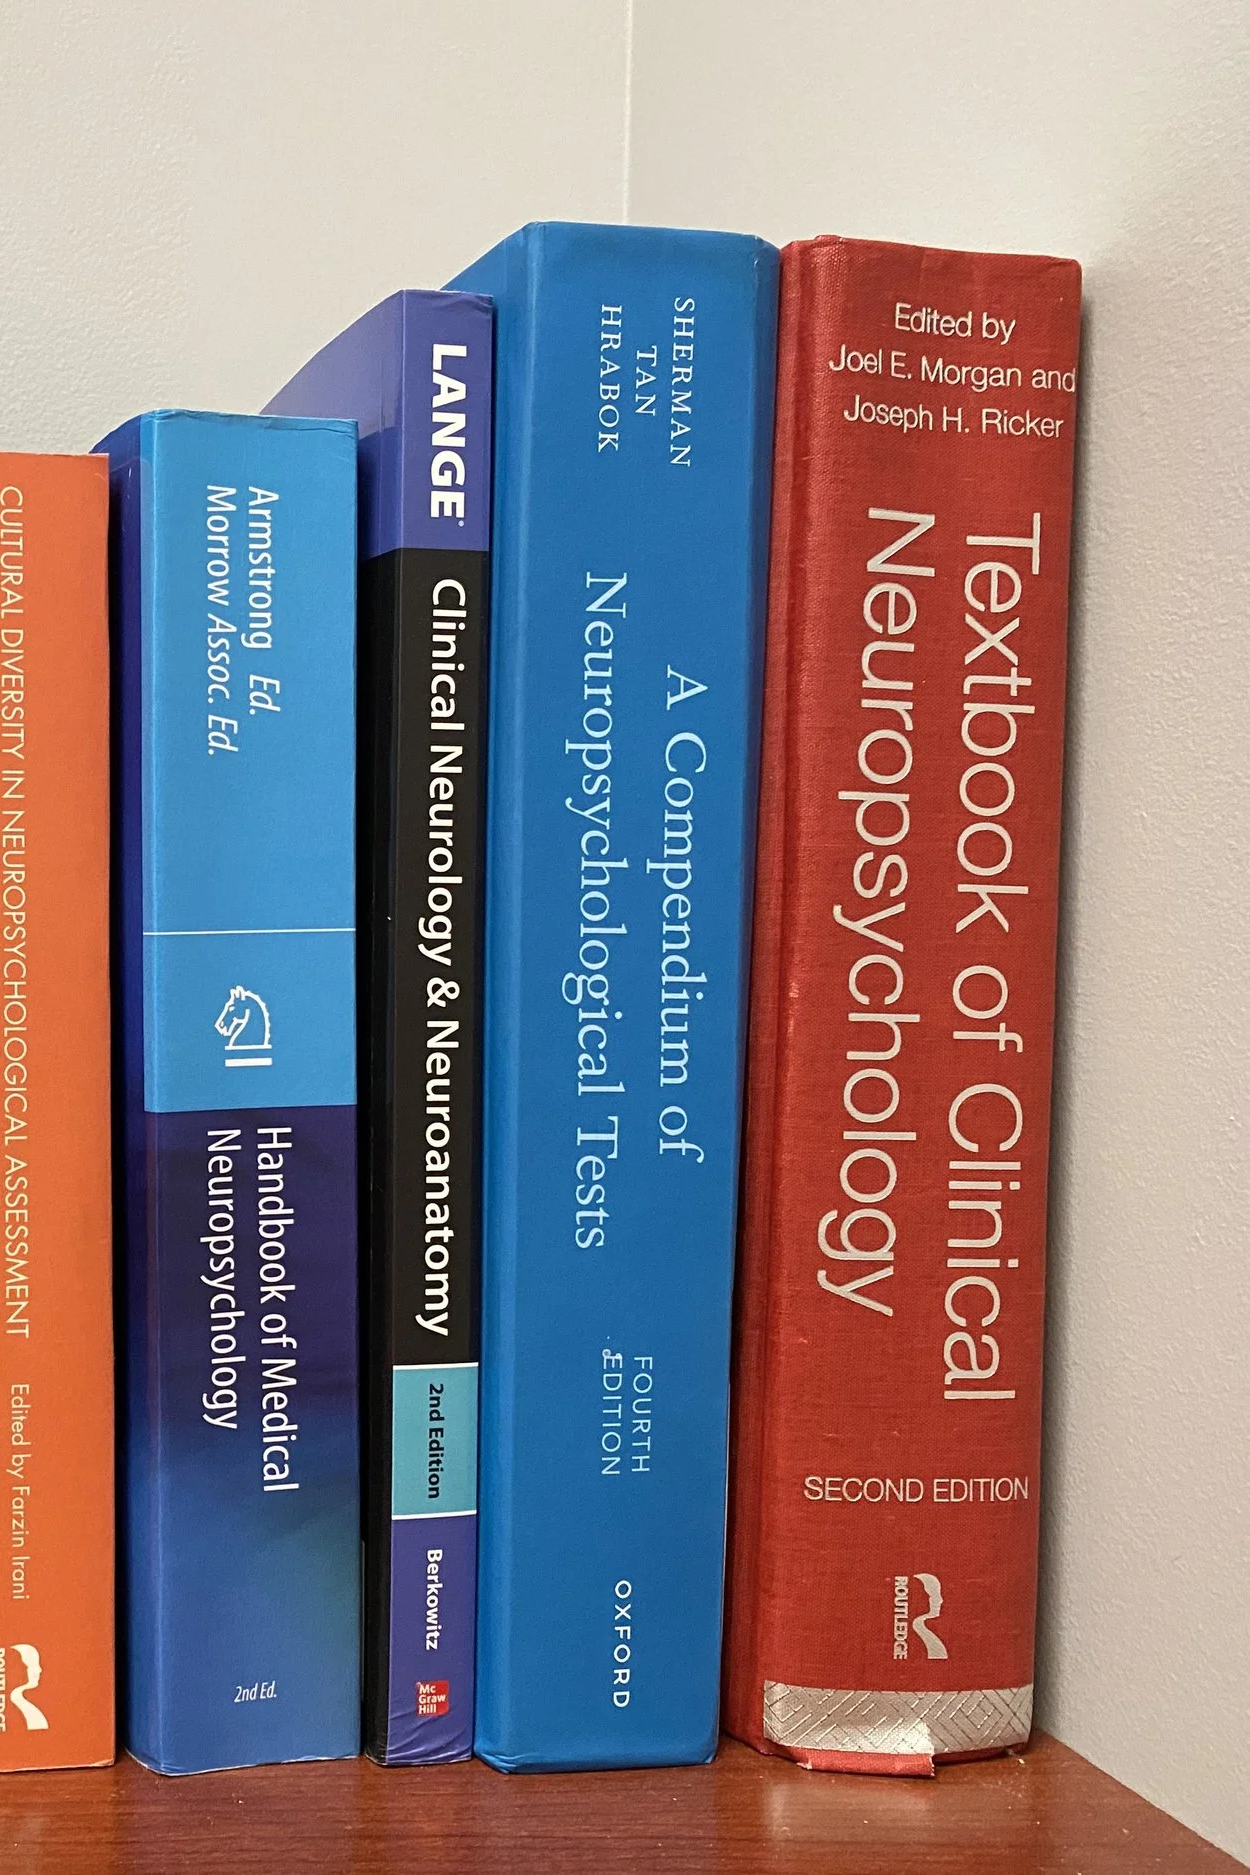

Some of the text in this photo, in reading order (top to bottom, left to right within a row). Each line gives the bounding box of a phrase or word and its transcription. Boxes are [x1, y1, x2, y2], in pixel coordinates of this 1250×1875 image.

[598, 304, 623, 453] HRABOK
[635, 345, 658, 417] TAN
[669, 297, 696, 467] SHERMAN
[828, 343, 1076, 393] Joel E. Morgan and
[894, 302, 1016, 346] Edited by
[843, 394, 1064, 438] Joseph H. Ricker
[206, 485, 239, 756] Morrow Assoc. Ed.
[240, 486, 281, 715] Armstrong Ed.
[0, 485, 30, 1339] CULTURAL DIVERSITY IN NEUROPSYCHOLOGICAL ASSESSMENT
[415, 578, 467, 1337] Clinical Neurology & Neuroanatomy
[561, 571, 629, 1249] Neuropsychological Tests
[646, 664, 709, 1164] A Compendium of
[816, 507, 936, 1317] Neuropsychology
[943, 512, 1041, 1400] Textbook of Clinical
[199, 1129, 247, 1430] Neuropsychology
[256, 1127, 300, 1492] Handbook of Medical
[427, 1383, 445, 1499] 2nd Edition
[601, 1350, 623, 1475] EDITION
[631, 1356, 653, 1472] FOURTH
[5, 1383, 32, 1600] Edited by Farzin Irani
[803, 1475, 1029, 1503] SECOND EDITION
[425, 1549, 443, 1651] Berkowitz
[613, 1579, 632, 1708] OXFORD
[893, 1575, 909, 1660] ROUTLEDGE
[233, 1680, 277, 1703] 2nd Ed.
[418, 1683, 437, 1695] Mc
[418, 1694, 446, 1705] Graw
[418, 1703, 437, 1715] Hill
